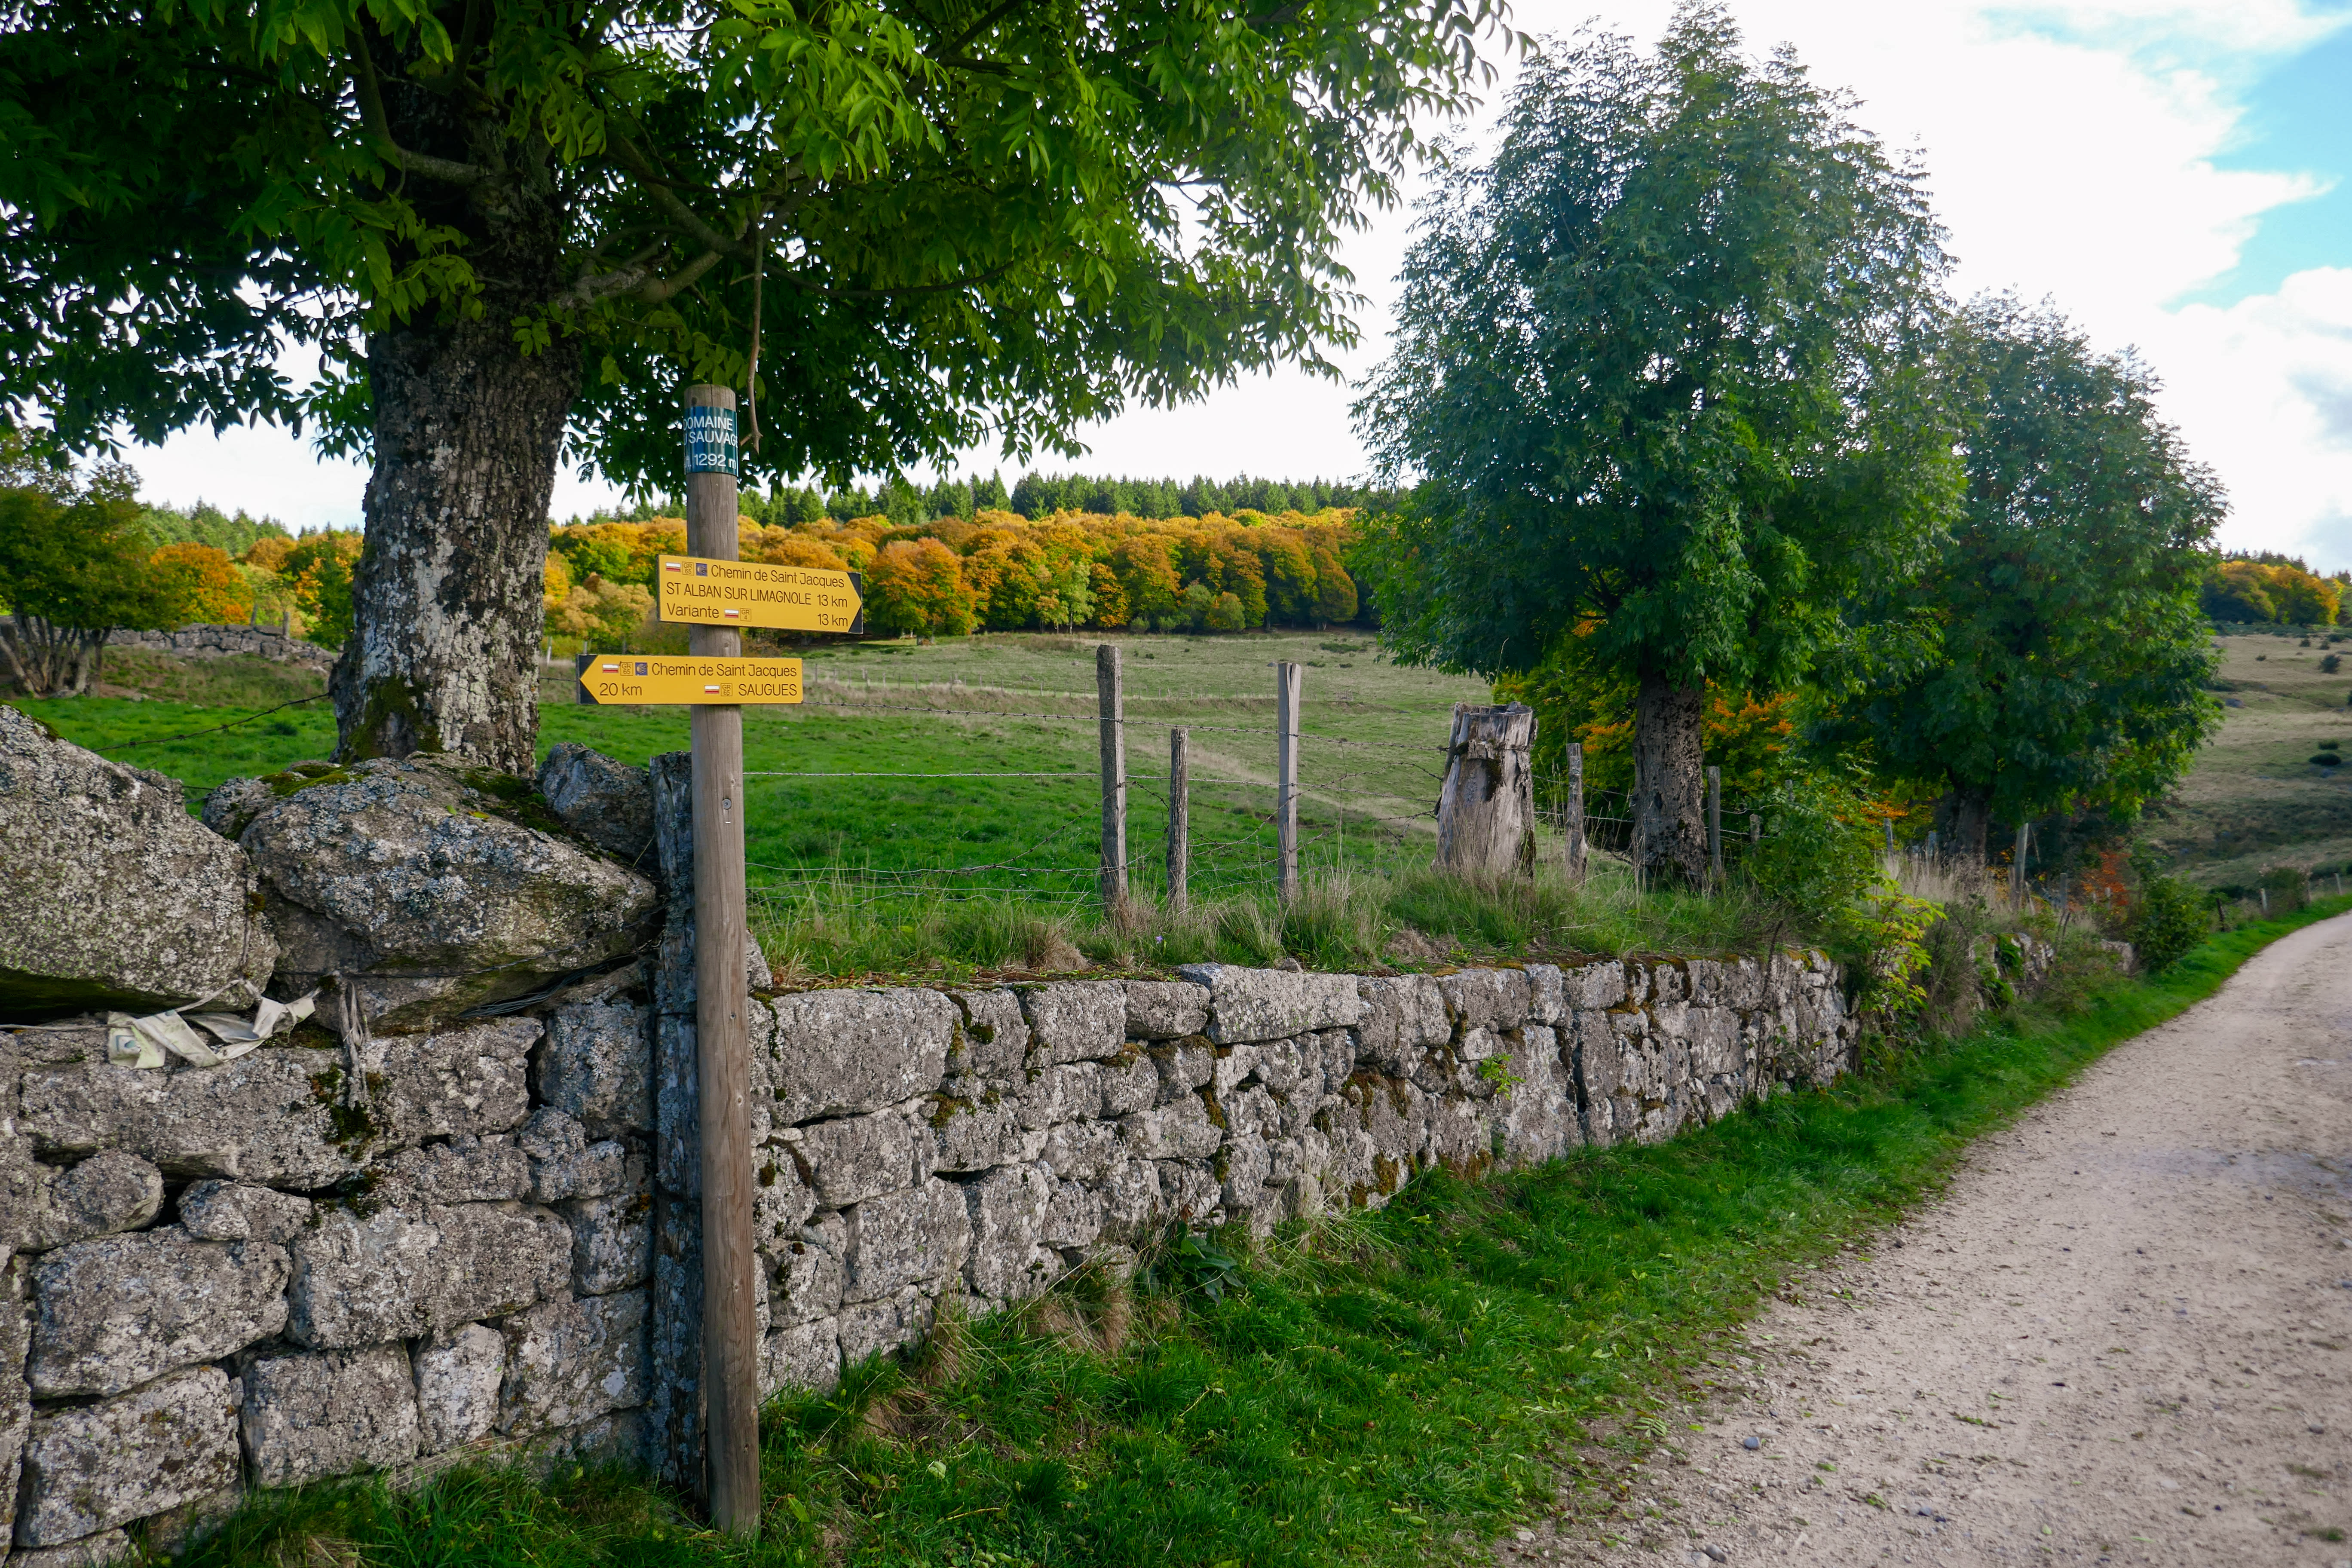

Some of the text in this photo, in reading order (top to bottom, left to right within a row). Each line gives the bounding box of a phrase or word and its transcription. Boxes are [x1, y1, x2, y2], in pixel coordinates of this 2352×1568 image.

[683, 416, 733, 431] DOMAINE
[694, 453, 726, 466] 1292
[728, 458, 736, 469] m
[711, 564, 844, 588] Chemin de Saint Jacques
[666, 582, 848, 608] ST ALBAN SUR LIMAGNOLE 13 km
[667, 603, 720, 618] Variante
[818, 613, 848, 627] 13 km
[652, 662, 796, 678] Chemin de Saint Jacques
[600, 683, 642, 696] 20 km
[738, 684, 797, 696] SAUGUES
